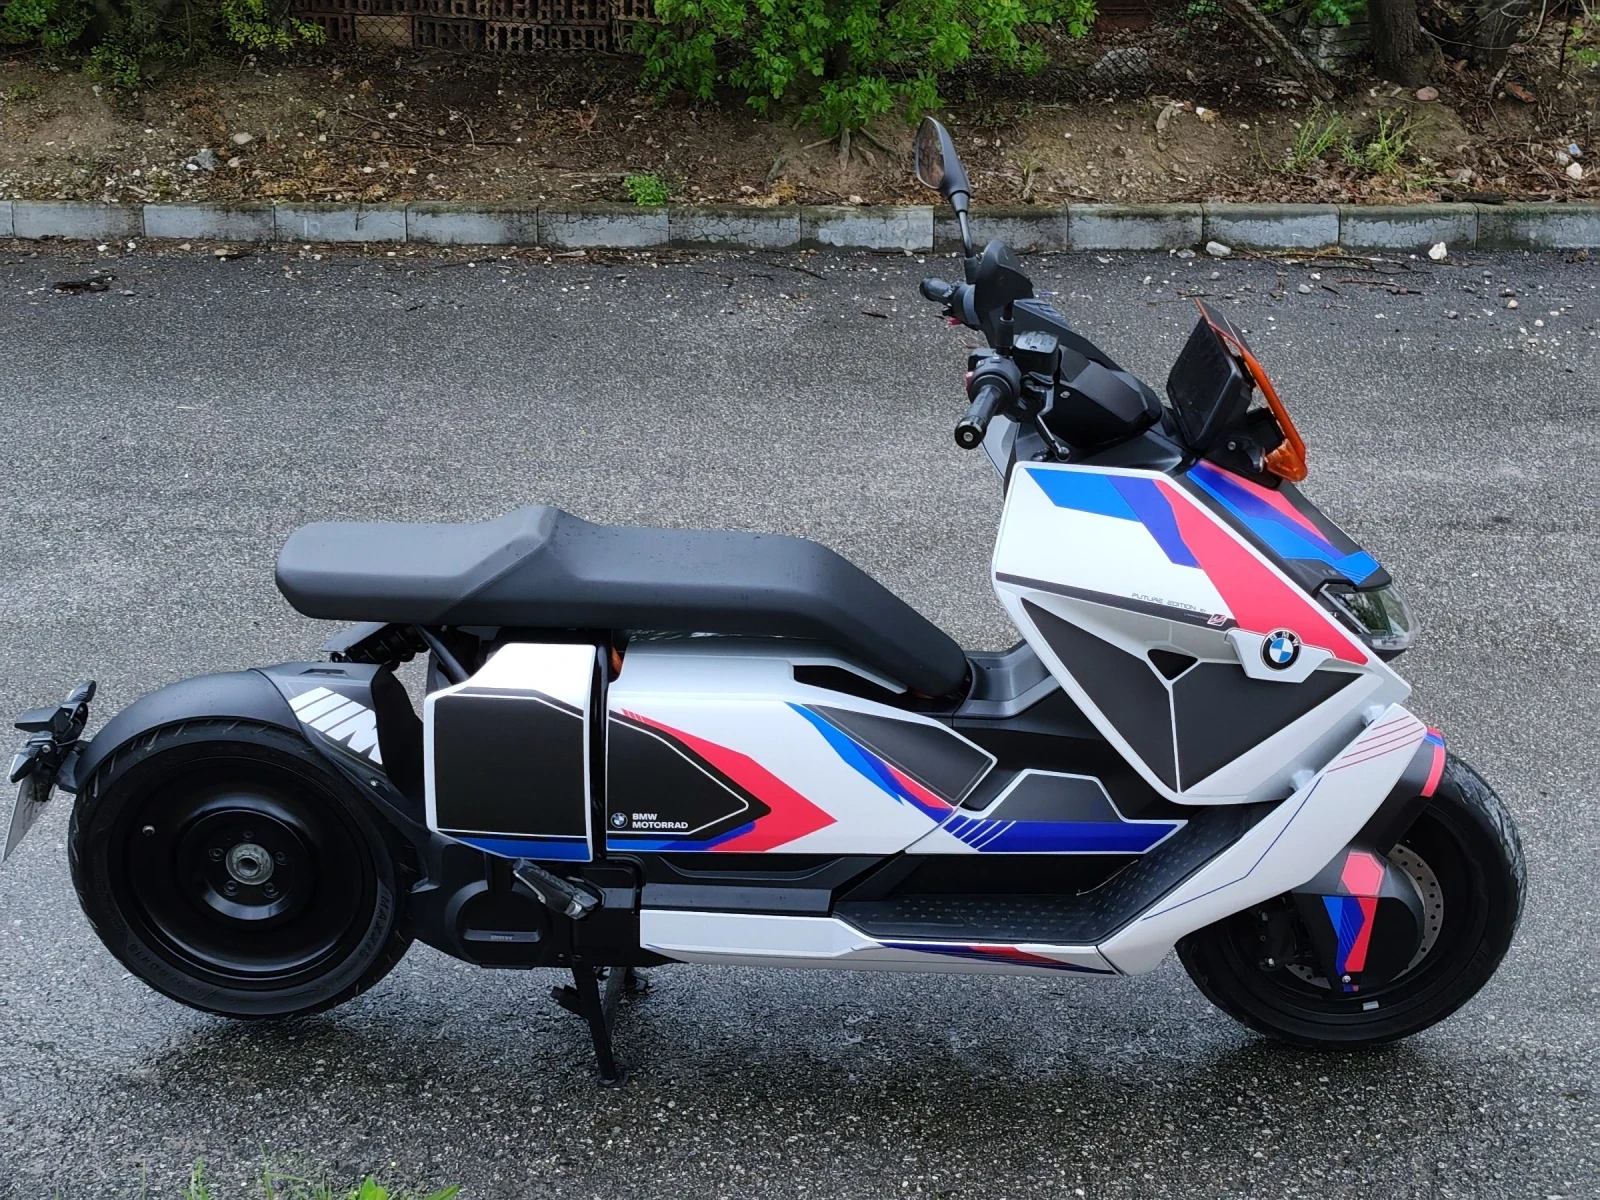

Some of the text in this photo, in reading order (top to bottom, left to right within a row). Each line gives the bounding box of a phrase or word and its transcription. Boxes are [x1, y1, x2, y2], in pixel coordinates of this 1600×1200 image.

[1131, 592, 1164, 604] FUTURE
[1166, 599, 1197, 611] EDITION
[1270, 630, 1300, 647] BMW
[632, 813, 658, 821] BMW
[632, 821, 689, 829] MOTORRAD
[359, 895, 390, 958] MAXXIS
